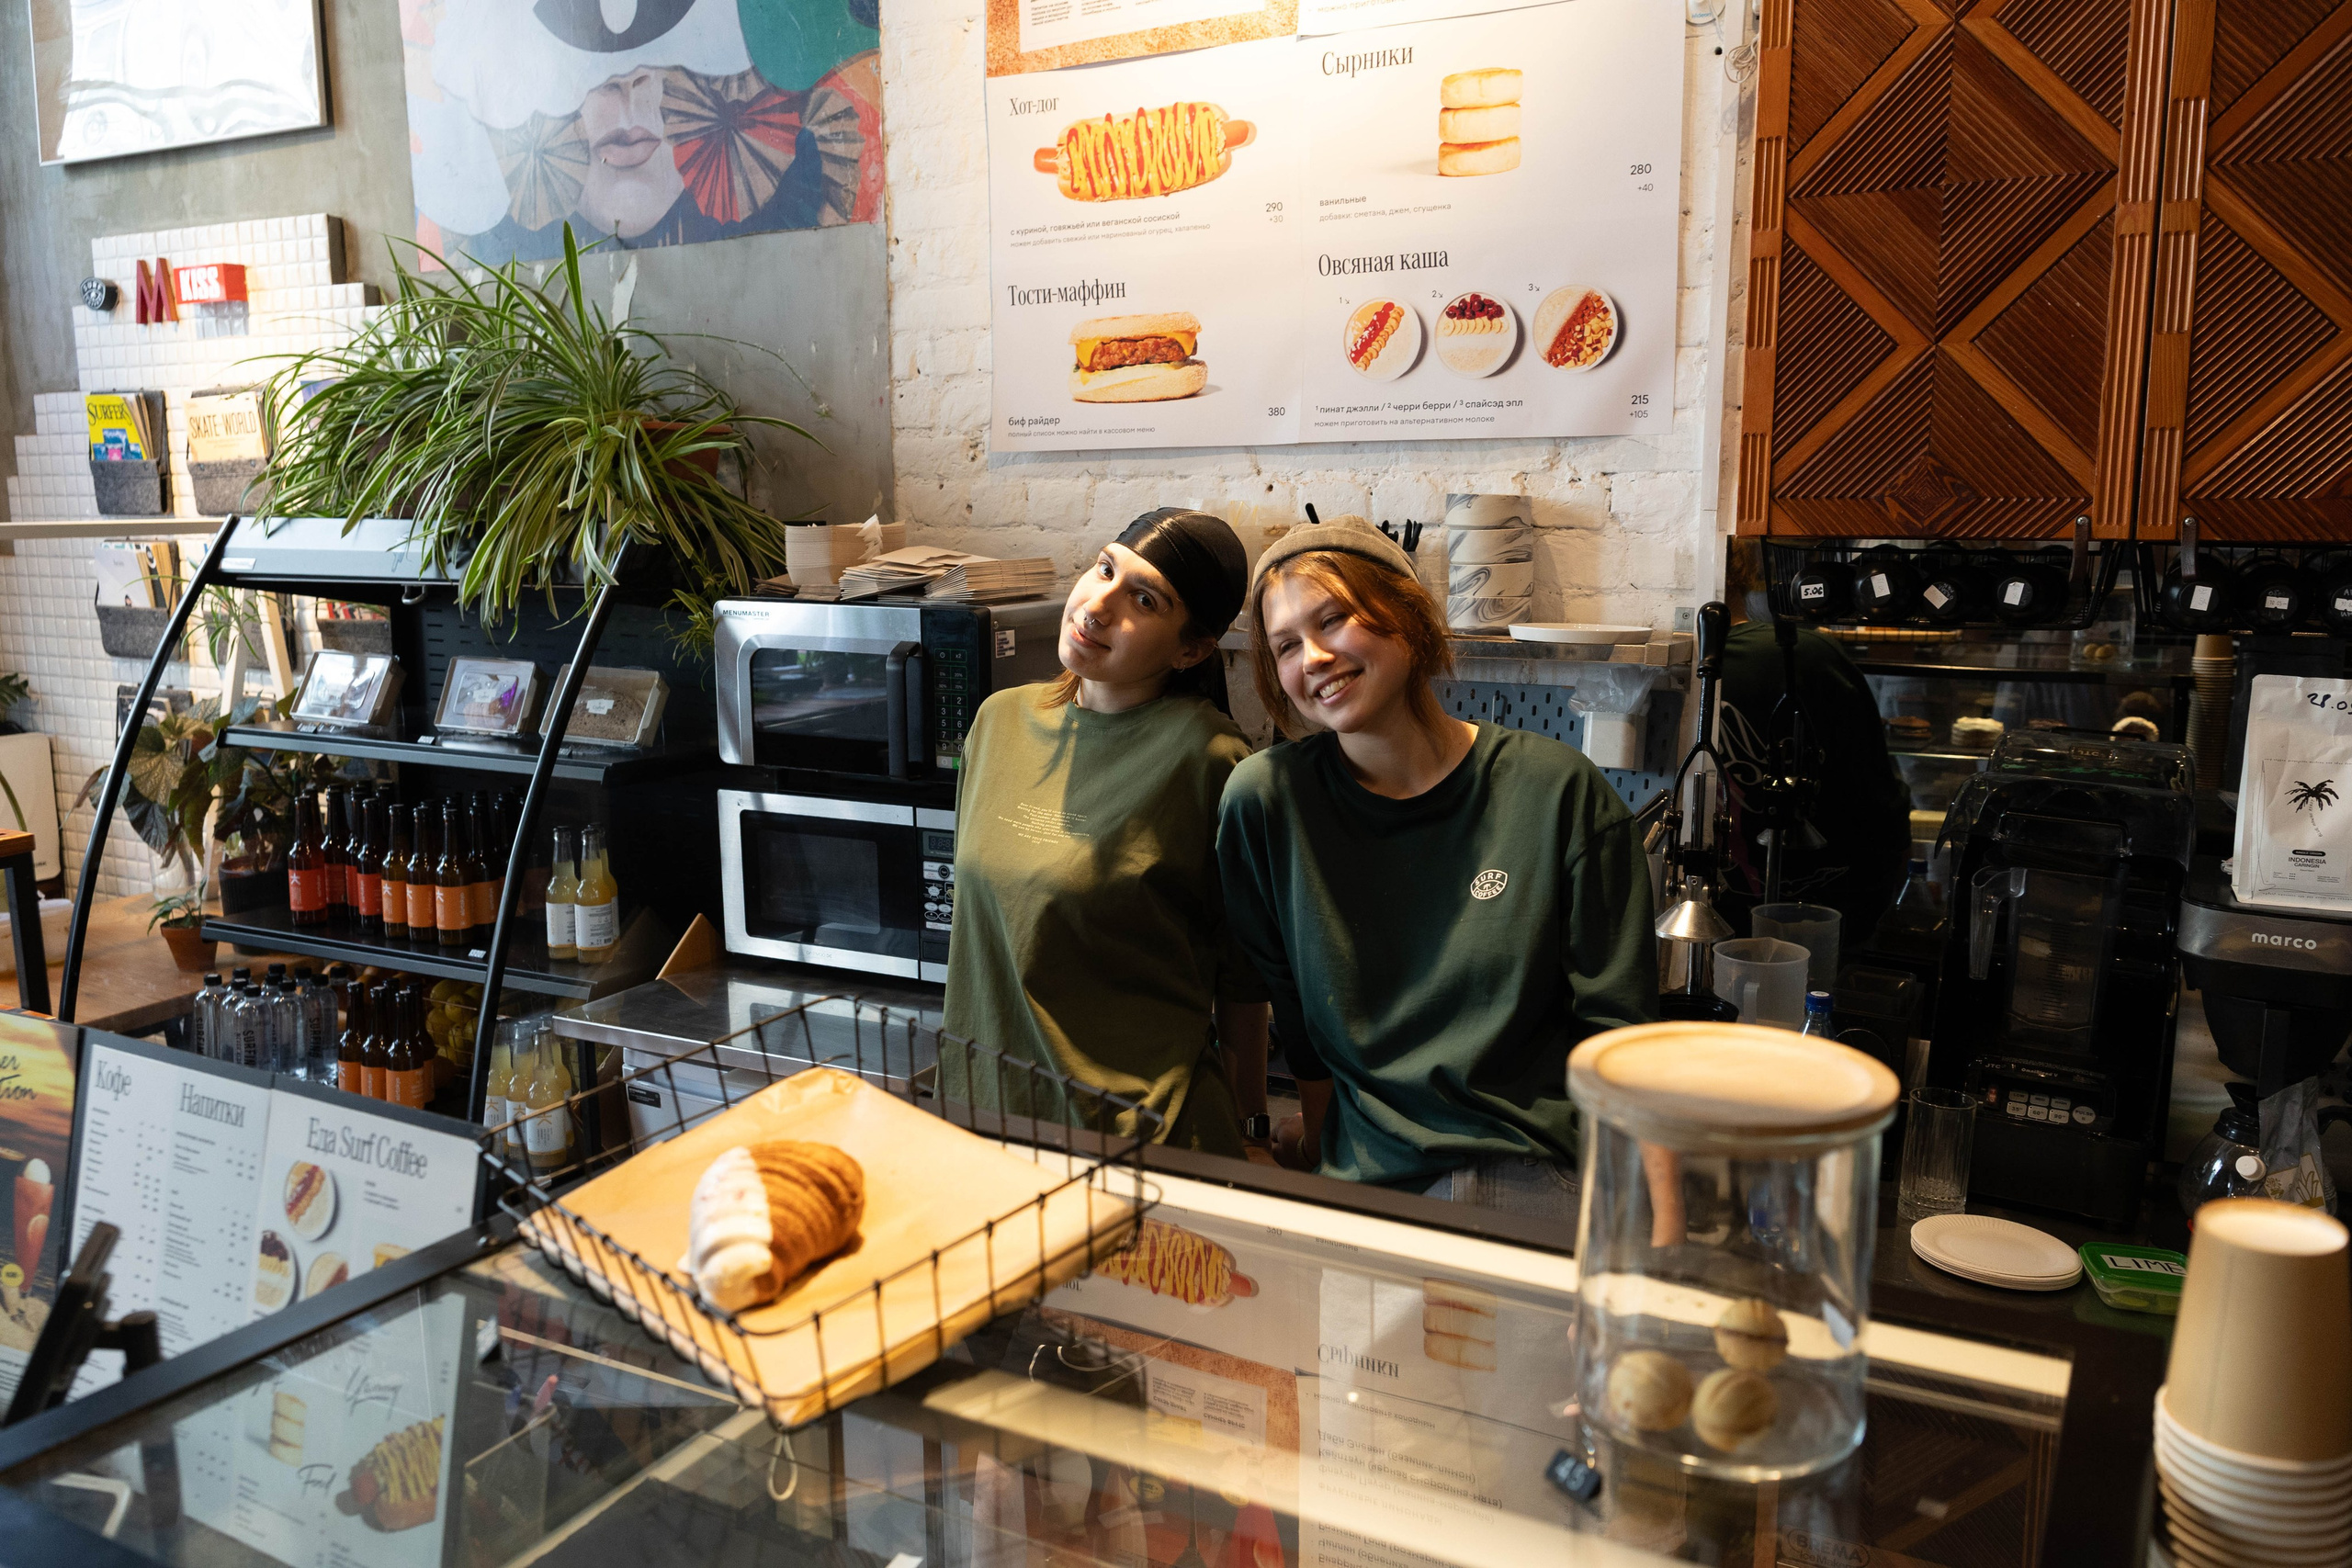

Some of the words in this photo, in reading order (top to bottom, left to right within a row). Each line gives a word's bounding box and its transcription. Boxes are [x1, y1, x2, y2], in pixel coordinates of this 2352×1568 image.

[1321, 46, 1414, 78] Сырники
[1009, 97, 1059, 116] Хот-дог
[1630, 164, 1652, 175] 280
[1637, 183, 1654, 192] +40
[1265, 201, 1283, 213] 290
[1319, 195, 1367, 207] ванильные
[1269, 214, 1283, 223] +30
[1319, 211, 1352, 222] добавки:
[1353, 209, 1387, 219] сметана,
[1388, 207, 1411, 216] джем,
[1413, 203, 1452, 213] сгущенка
[1016, 225, 1048, 236] куриной,
[1050, 221, 1085, 231] говяжьей
[1102, 216, 1142, 227] веганской
[1143, 211, 1181, 222] сосиской
[1032, 237, 1062, 246] добавить
[1063, 234, 1086, 243] свежий
[1175, 223, 1211, 232] халапеньо
[1318, 253, 1395, 277] Овсяная
[1399, 250, 1449, 270] каша
[179, 266, 220, 301] KISS
[1008, 277, 1126, 308] Тости-маффин
[1431, 290, 1437, 299] 2
[1346, 404, 1379, 413] джэлли
[1393, 404, 1420, 412] черри
[1422, 400, 1451, 412] берри
[1464, 399, 1504, 409] спайсэд
[1631, 394, 1649, 406] 215
[86, 402, 132, 425] SURFERS
[1268, 407, 1285, 417] 380
[1630, 410, 1649, 419] +105
[189, 414, 219, 439] SKATE
[221, 412, 257, 435] WORLD
[1008, 416, 1027, 428] биф
[1028, 415, 1060, 427] райдер
[1399, 417, 1464, 426] альтернативном
[1033, 430, 1056, 438] список
[1804, 586, 1824, 597] 5.06
[722, 609, 770, 617] MENUMASTER
[1476, 872, 1502, 886] SURF
[1475, 885, 1502, 897] COFFEE
[2251, 932, 2317, 950] marco
[96, 1059, 132, 1100] Кофе
[179, 1082, 246, 1128] Напитки
[307, 1117, 337, 1156] Еда
[338, 1125, 377, 1165] Surf
[376, 1135, 428, 1179] Coffee
[2109, 1256, 2187, 1276] LIME
